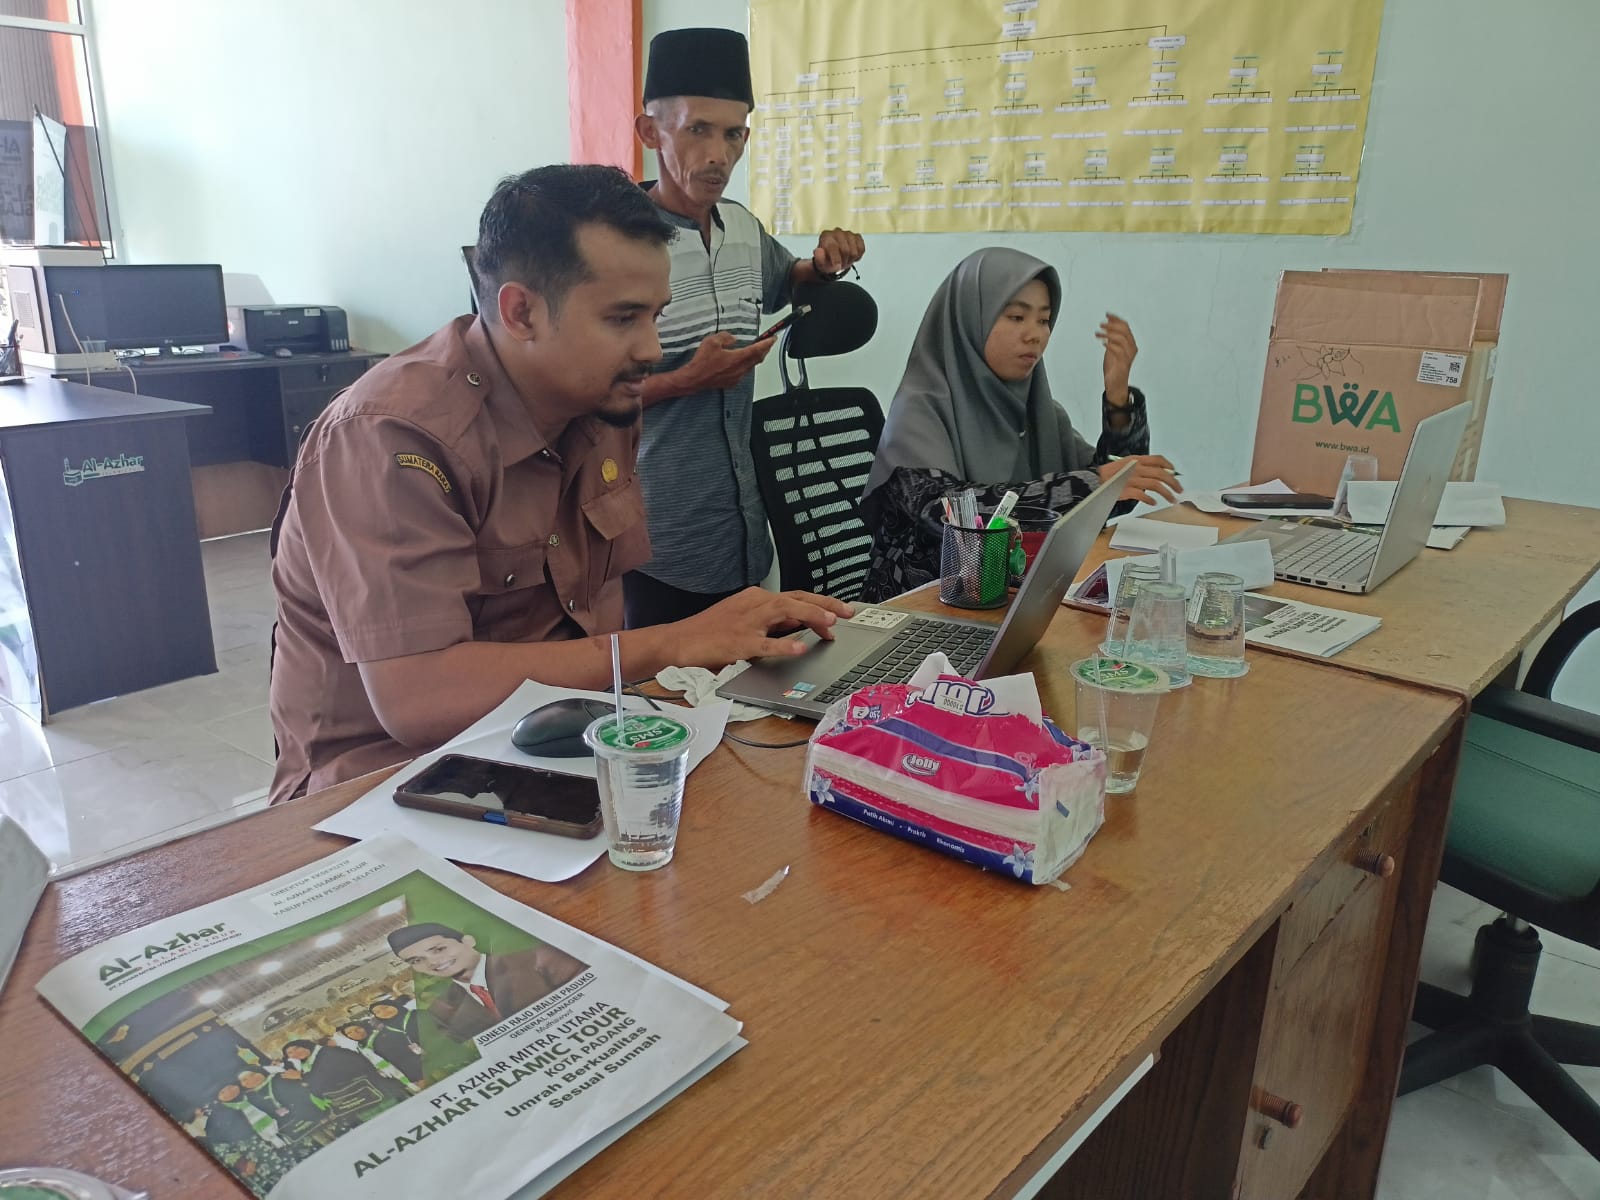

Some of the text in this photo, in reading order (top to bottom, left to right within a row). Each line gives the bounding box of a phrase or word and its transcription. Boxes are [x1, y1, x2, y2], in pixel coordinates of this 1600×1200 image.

[1292, 382, 1402, 433] BWA
[82, 453, 144, 472] Al-Azhar
[1314, 441, 1370, 454] www.bwa.id
[902, 753, 942, 776] Jolly
[863, 808, 878, 820] Putih
[936, 837, 965, 854] Ekonomis
[99, 922, 226, 981] Al-Azhar
[476, 972, 595, 1045] JONEDI RAJO MALIN PADUKO
[509, 992, 585, 1039] GENERAL MANAGER
[429, 1000, 610, 1109] PT. AZHAR MITRA UTAMA
[504, 1025, 648, 1118] Umrah Berkualitas
[544, 1016, 636, 1078] KOTA PADANG
[548, 1033, 662, 1109] Sesuai Sunnah
[353, 1006, 627, 1179] AL-AZHAR ISLAMIC TOUR
